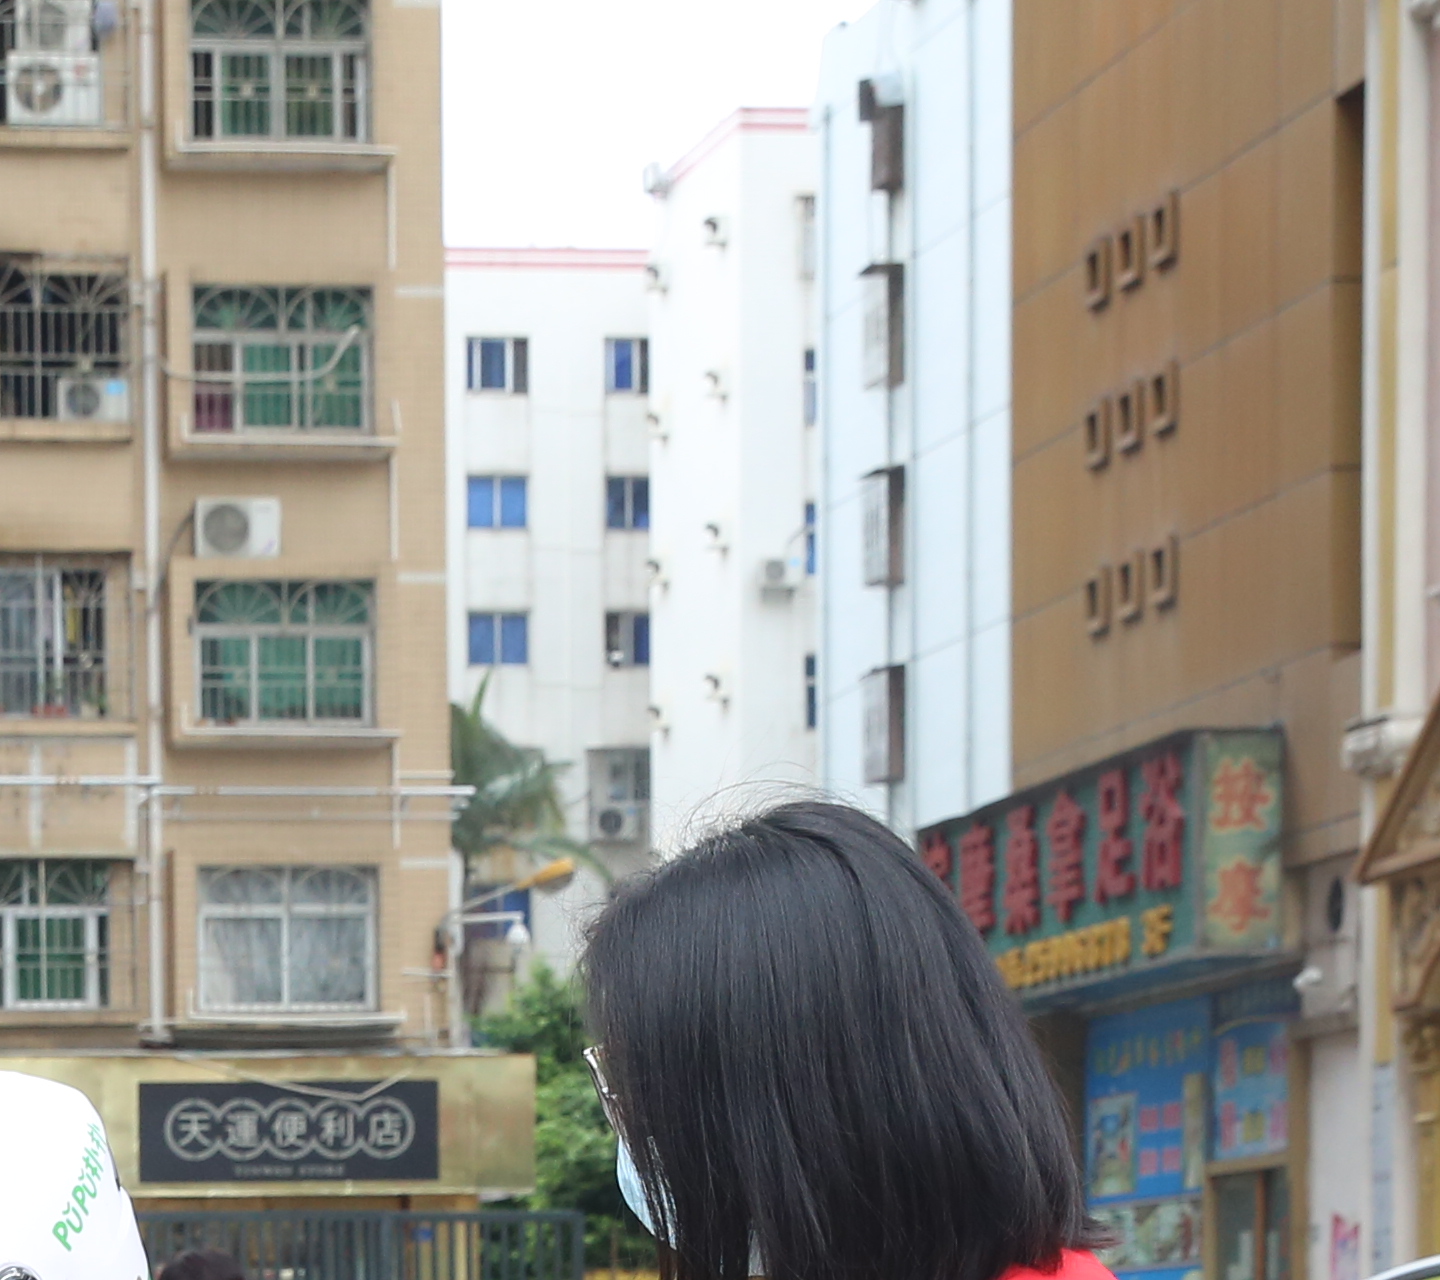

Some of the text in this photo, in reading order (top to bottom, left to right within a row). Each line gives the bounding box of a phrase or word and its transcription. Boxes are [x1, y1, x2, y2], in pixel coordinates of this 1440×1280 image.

[177, 1108, 405, 1149] 天運便利店
